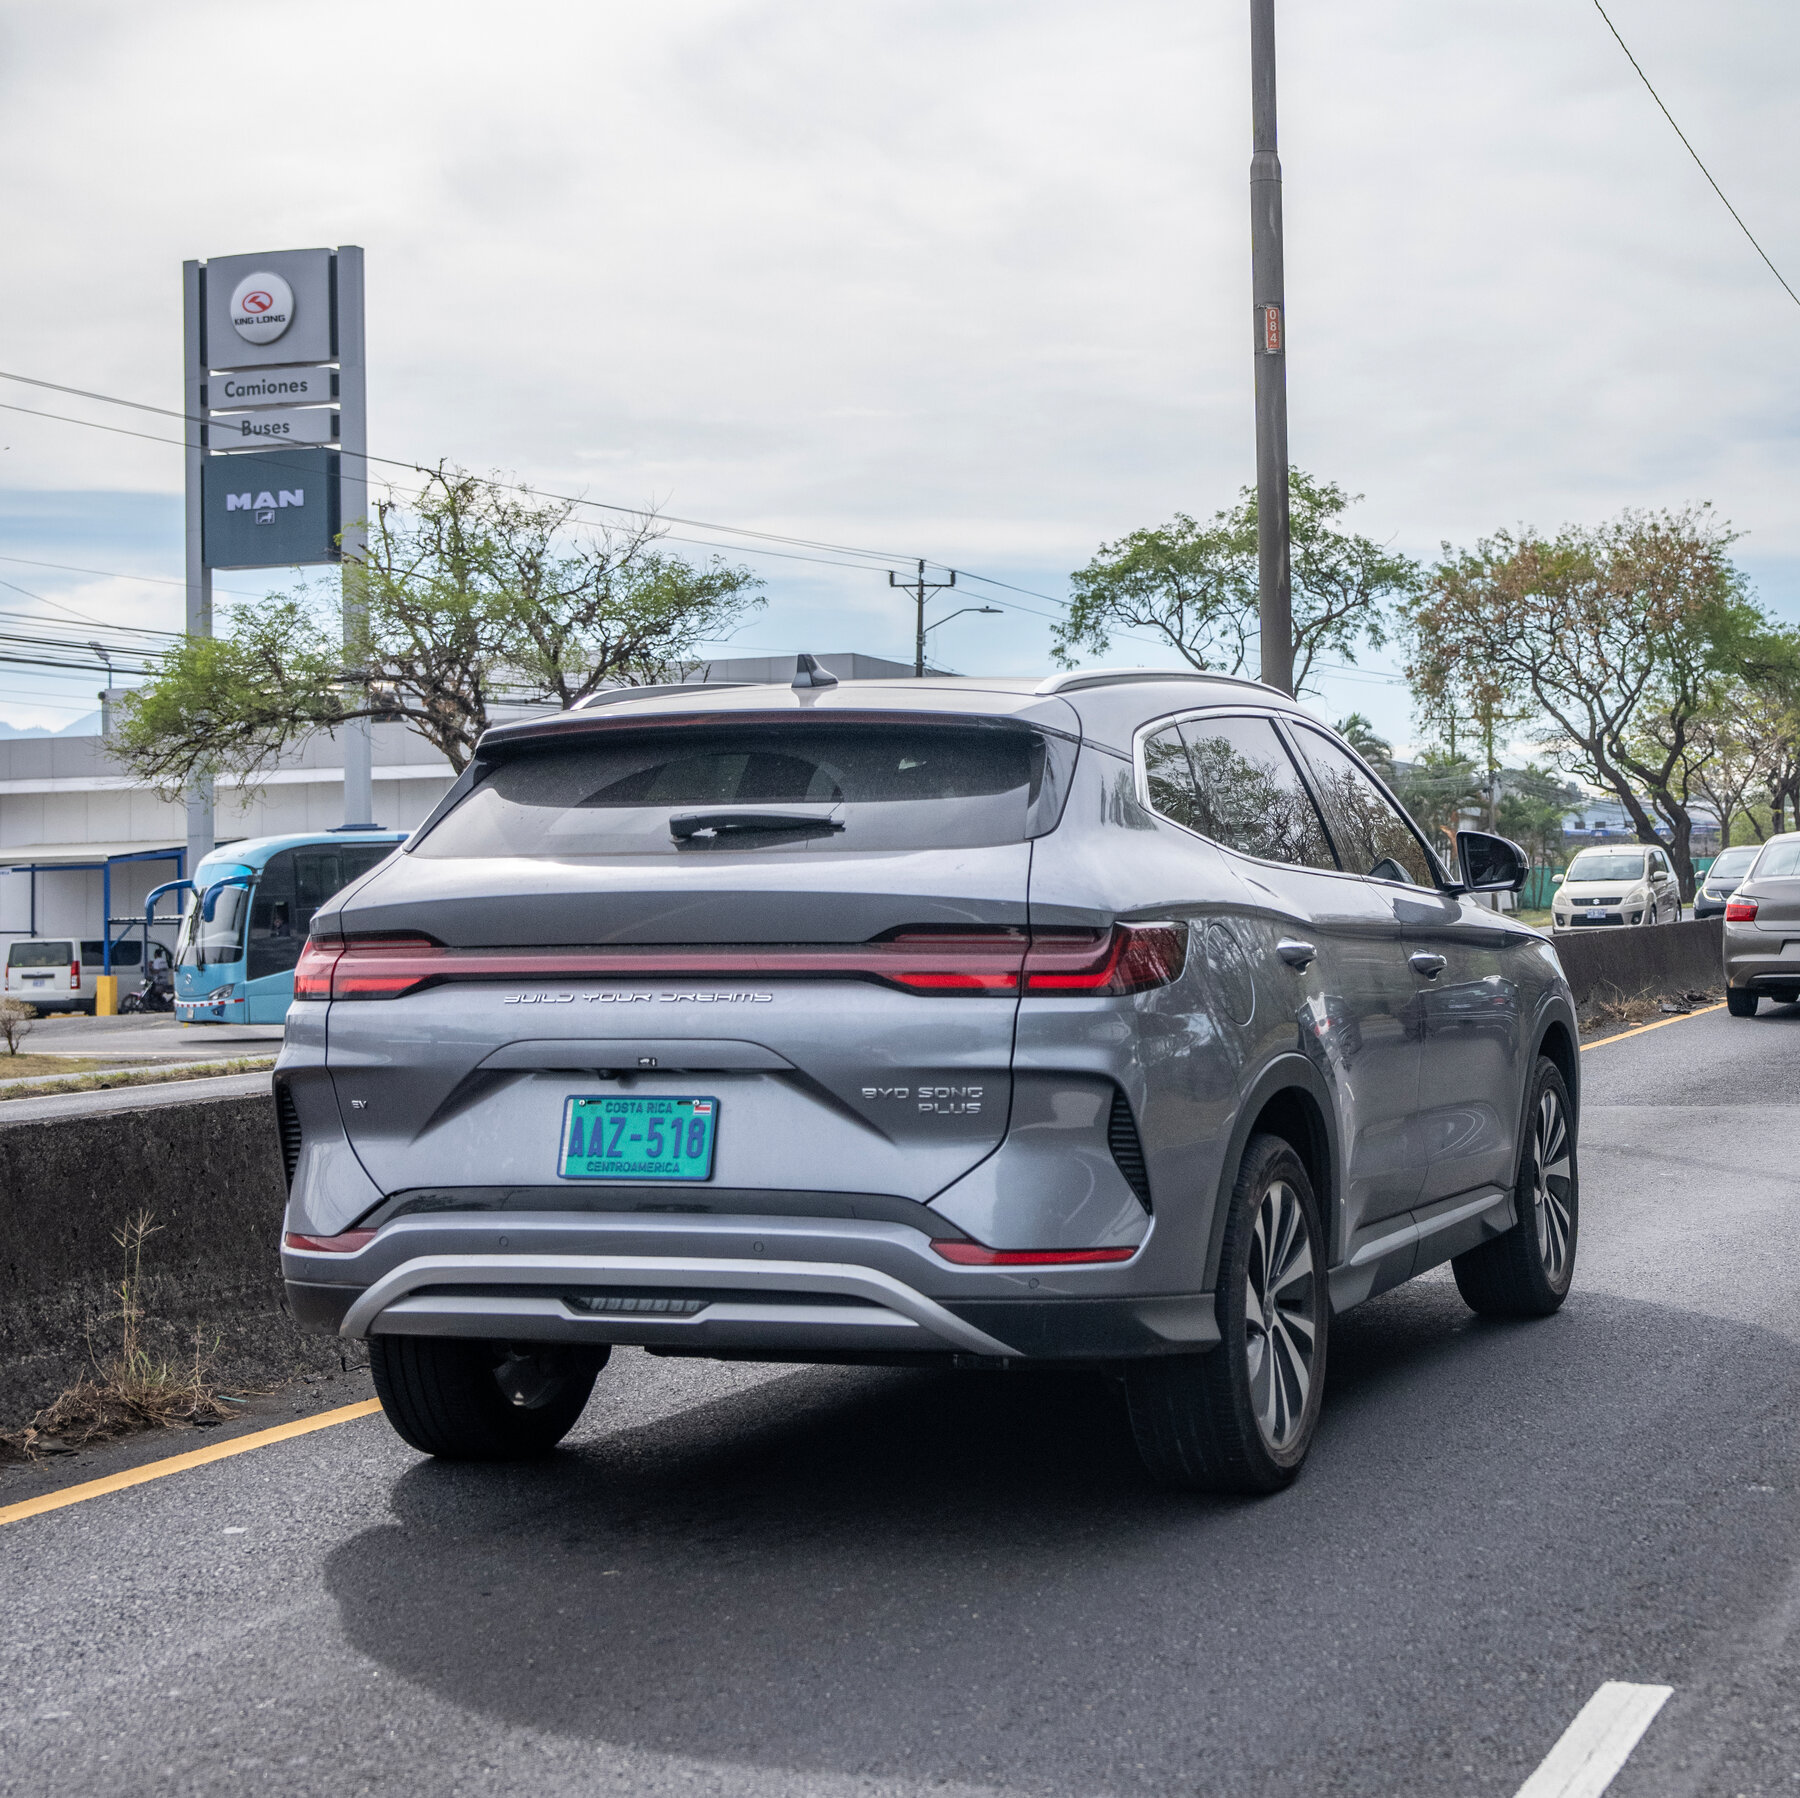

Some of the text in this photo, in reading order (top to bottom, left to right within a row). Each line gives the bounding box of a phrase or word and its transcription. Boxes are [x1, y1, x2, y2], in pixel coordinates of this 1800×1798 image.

[234, 314, 286, 325] KING LONG
[1269, 309, 1277, 343] 084
[224, 379, 308, 398] Camiones
[241, 420, 290, 436] Buses
[226, 489, 304, 511] MAN
[504, 993, 773, 1003] BUILD YOUR DREAMS
[861, 1086, 983, 1099] BYD SONG
[351, 1100, 367, 1109] EV
[605, 1102, 673, 1114] COSTA RICA
[918, 1103, 981, 1114] PLUS
[568, 1116, 706, 1159] AAZ-518
[586, 1161, 680, 1173] CENTROAMERICA
